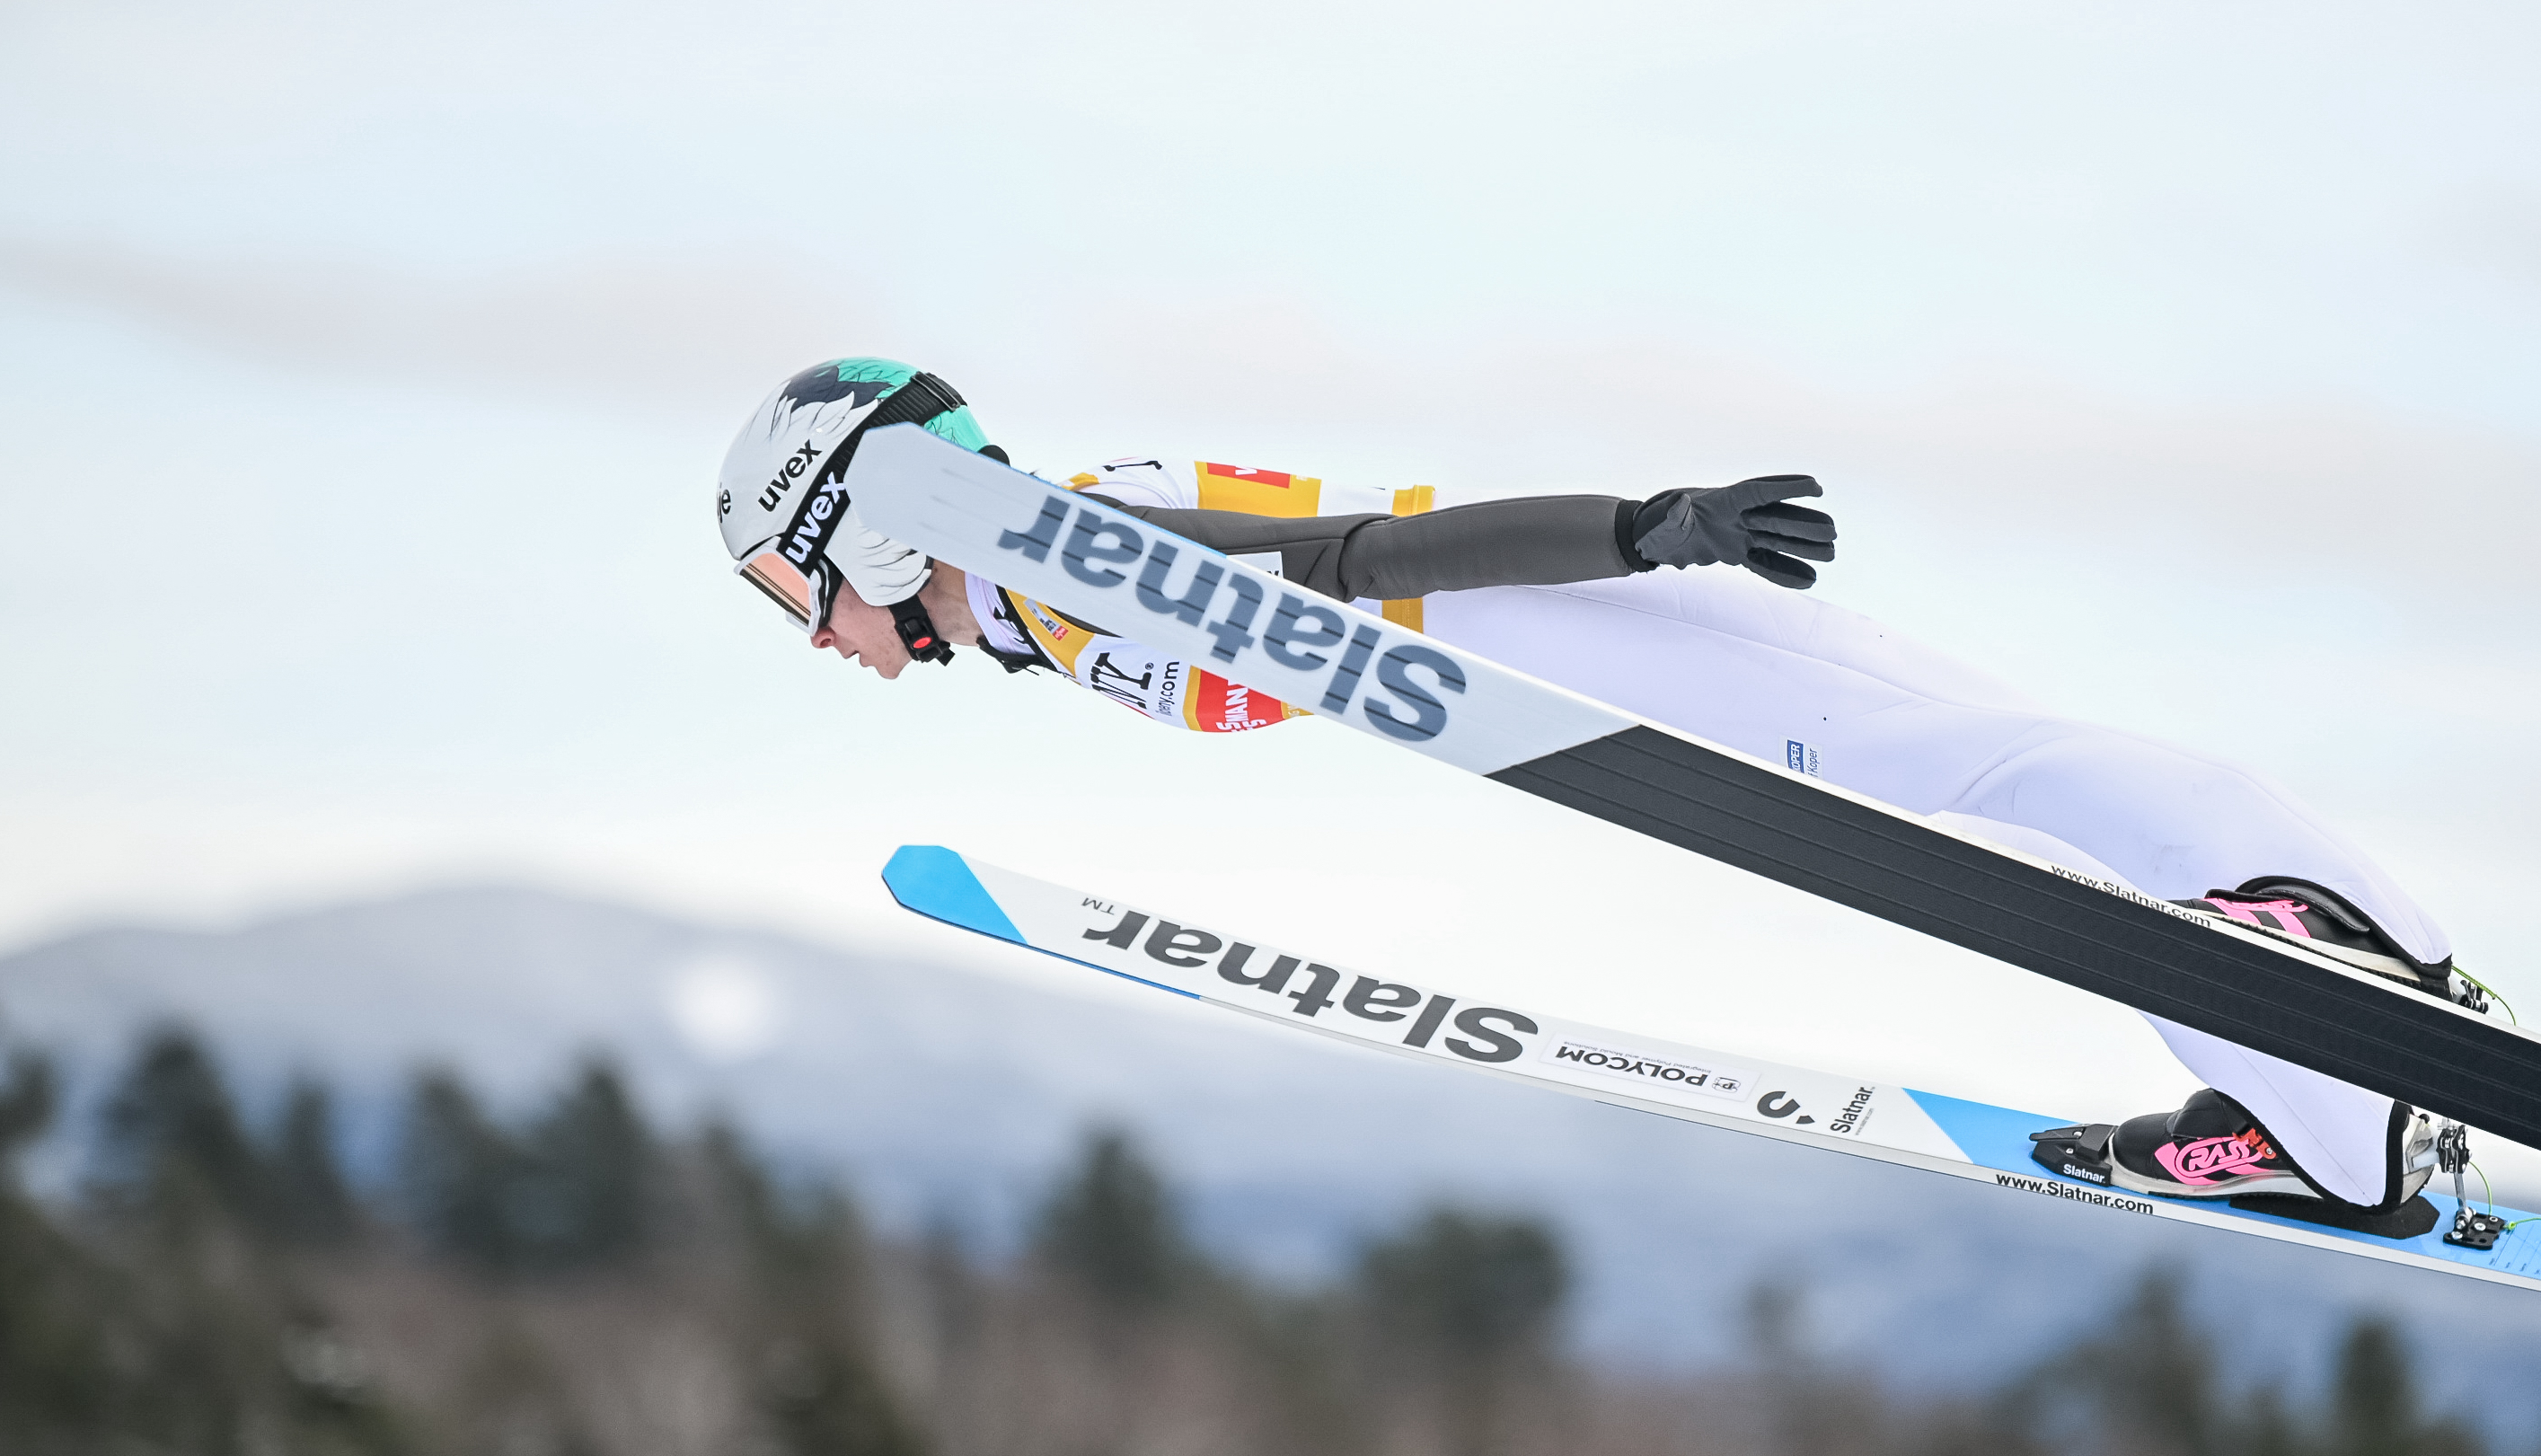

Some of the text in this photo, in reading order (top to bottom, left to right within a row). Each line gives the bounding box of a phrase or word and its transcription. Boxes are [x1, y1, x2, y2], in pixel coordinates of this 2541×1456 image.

[757, 438, 822, 512] uvex
[785, 471, 846, 564] uvex
[996, 495, 1466, 742] Slatnar
[1806, 747, 1821, 774] Koper
[2051, 865, 2211, 928] www.Slatnar.com
[1081, 910, 1539, 1063] Slatnar
[1555, 1046, 1708, 1087] POLYCOM
[1830, 1087, 1873, 1133] Slatnar
[1996, 1173, 2154, 1214] www.Slatnar.com
[2063, 1163, 2105, 1183] Slatnar
